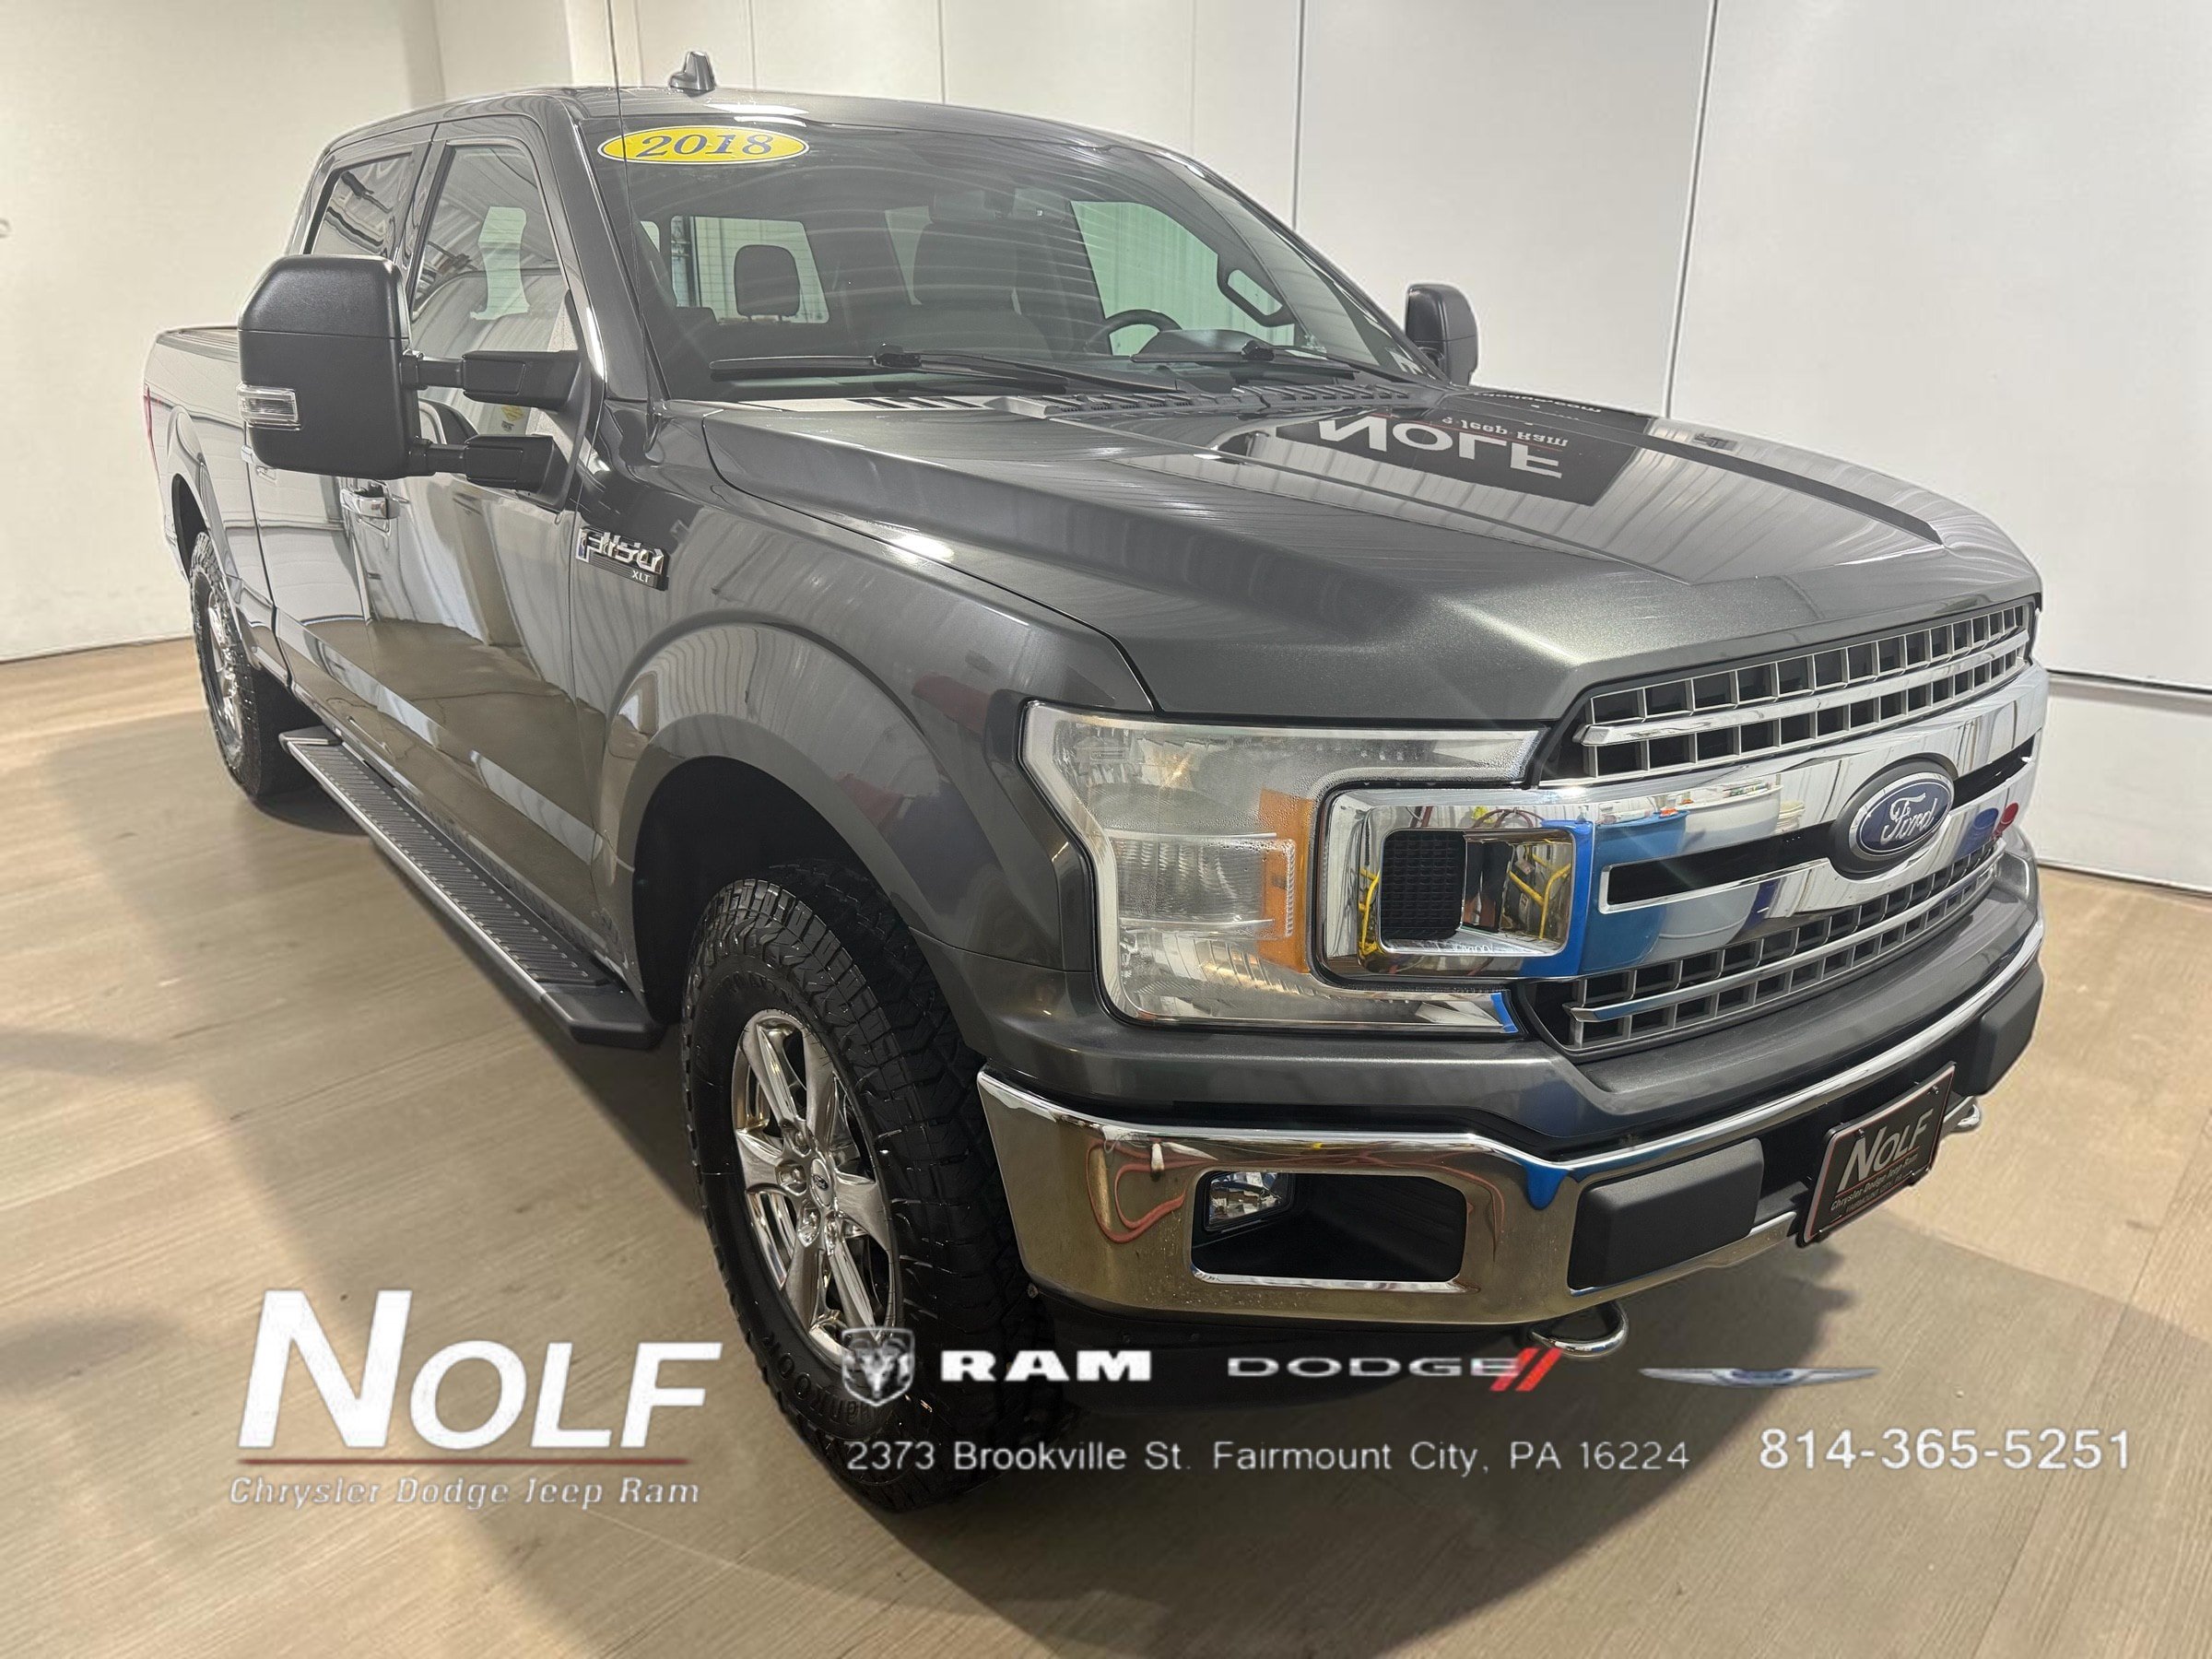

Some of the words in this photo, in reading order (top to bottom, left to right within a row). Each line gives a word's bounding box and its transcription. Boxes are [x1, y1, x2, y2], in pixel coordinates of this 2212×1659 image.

[636, 134, 773, 158] 2018
[631, 570, 651, 583] XLT
[1880, 792, 1938, 846] Ford
